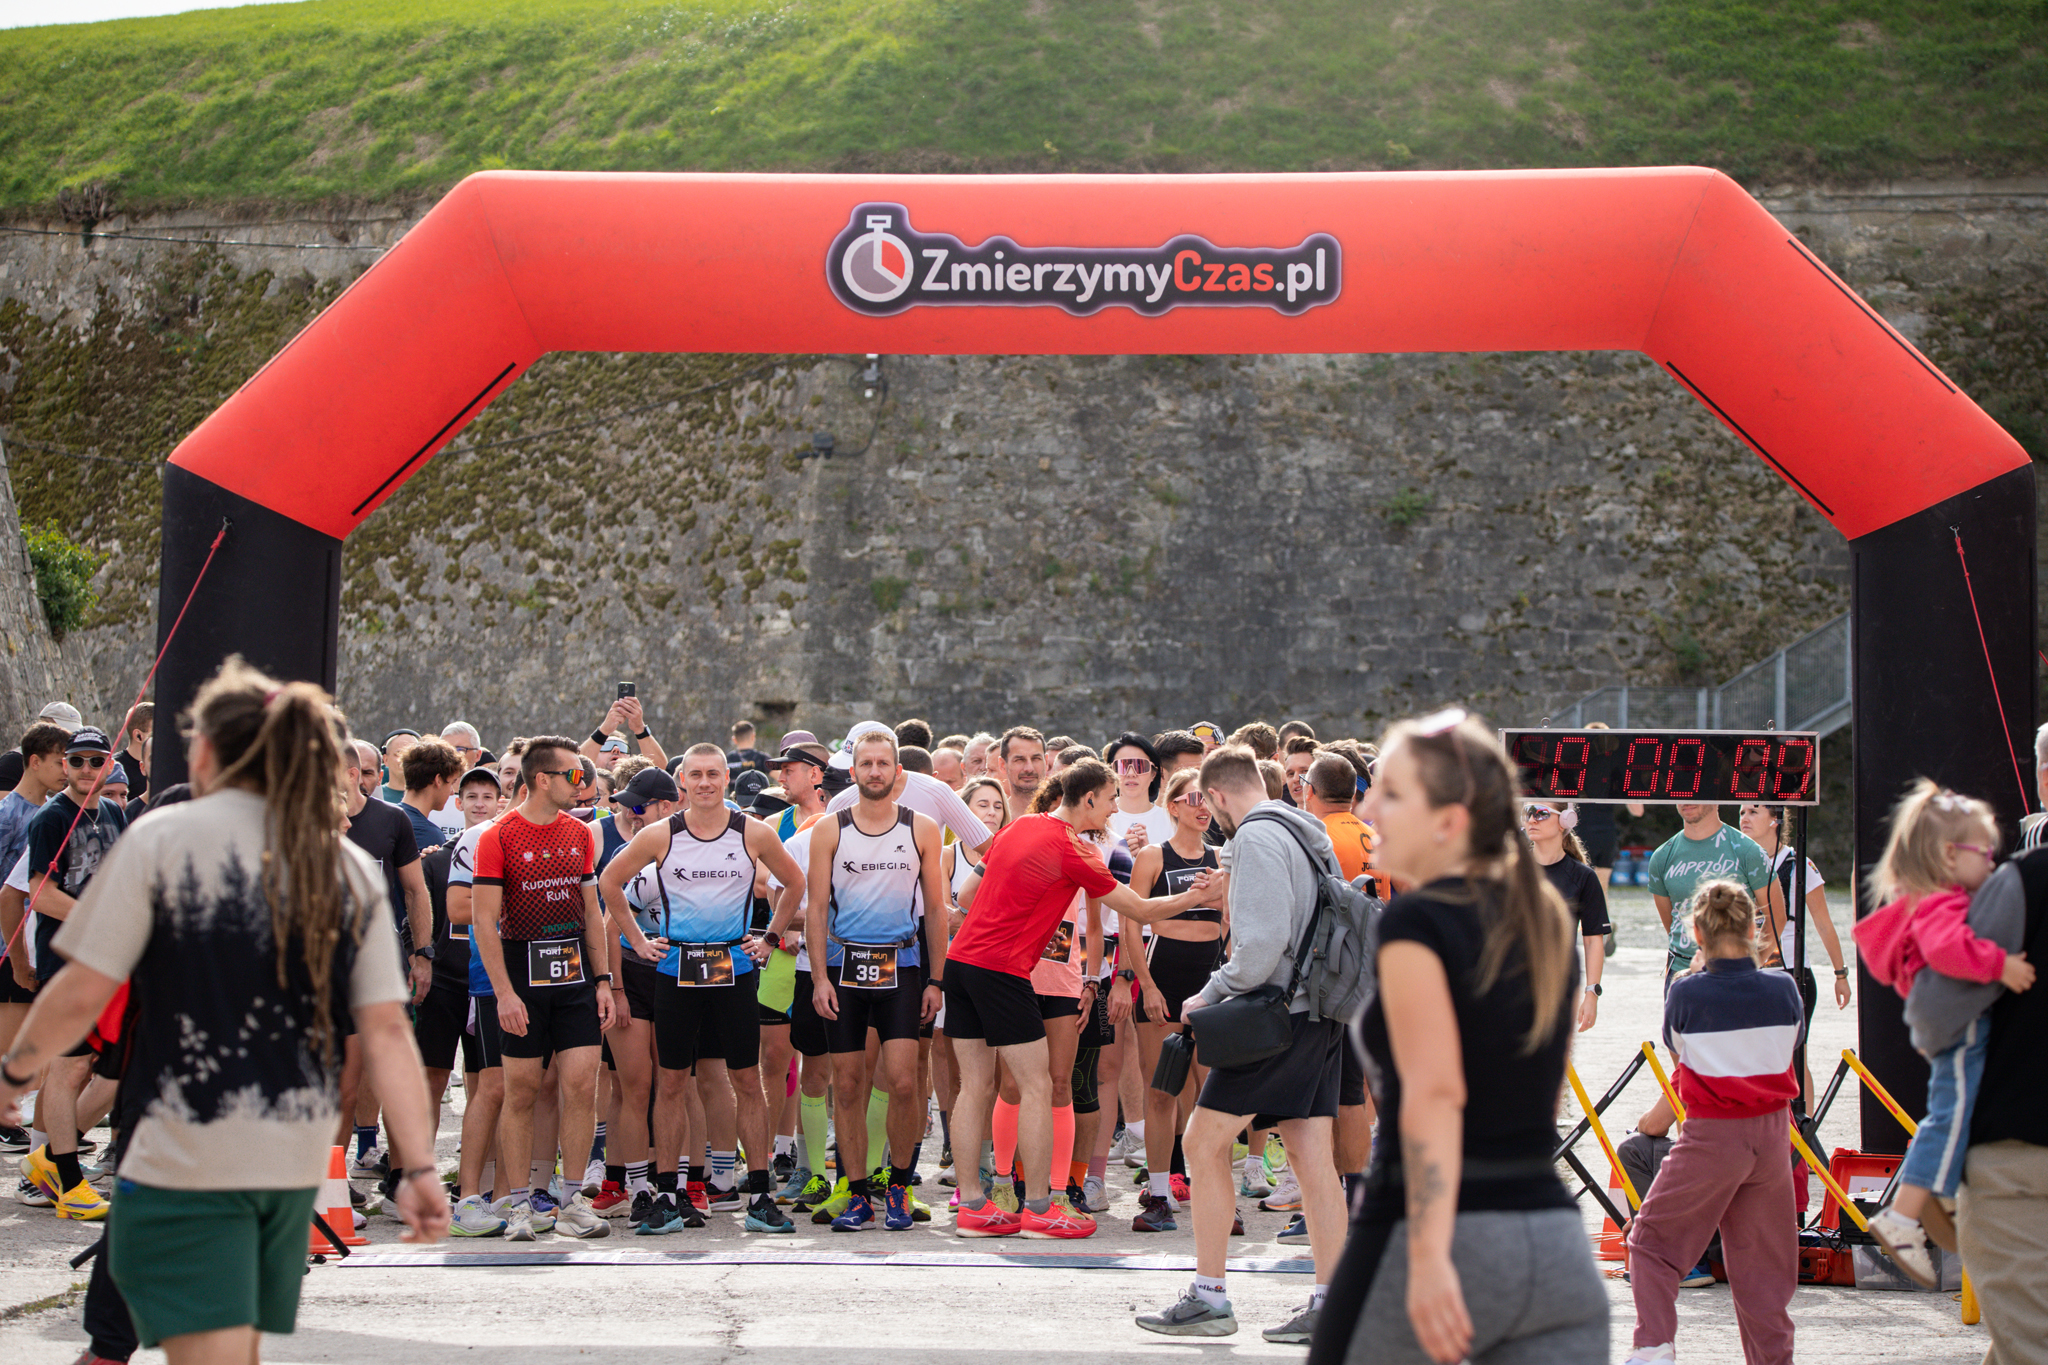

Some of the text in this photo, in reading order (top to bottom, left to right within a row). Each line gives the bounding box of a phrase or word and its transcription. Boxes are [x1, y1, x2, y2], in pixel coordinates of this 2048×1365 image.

[922, 249, 1326, 302] ZmierzymyCzas.pl
[692, 870, 743, 879] EBIEGI.PL
[861, 863, 911, 871] EBIEGI.PL
[550, 960, 569, 978] 61
[700, 963, 708, 979] 1
[856, 964, 880, 981] 39
